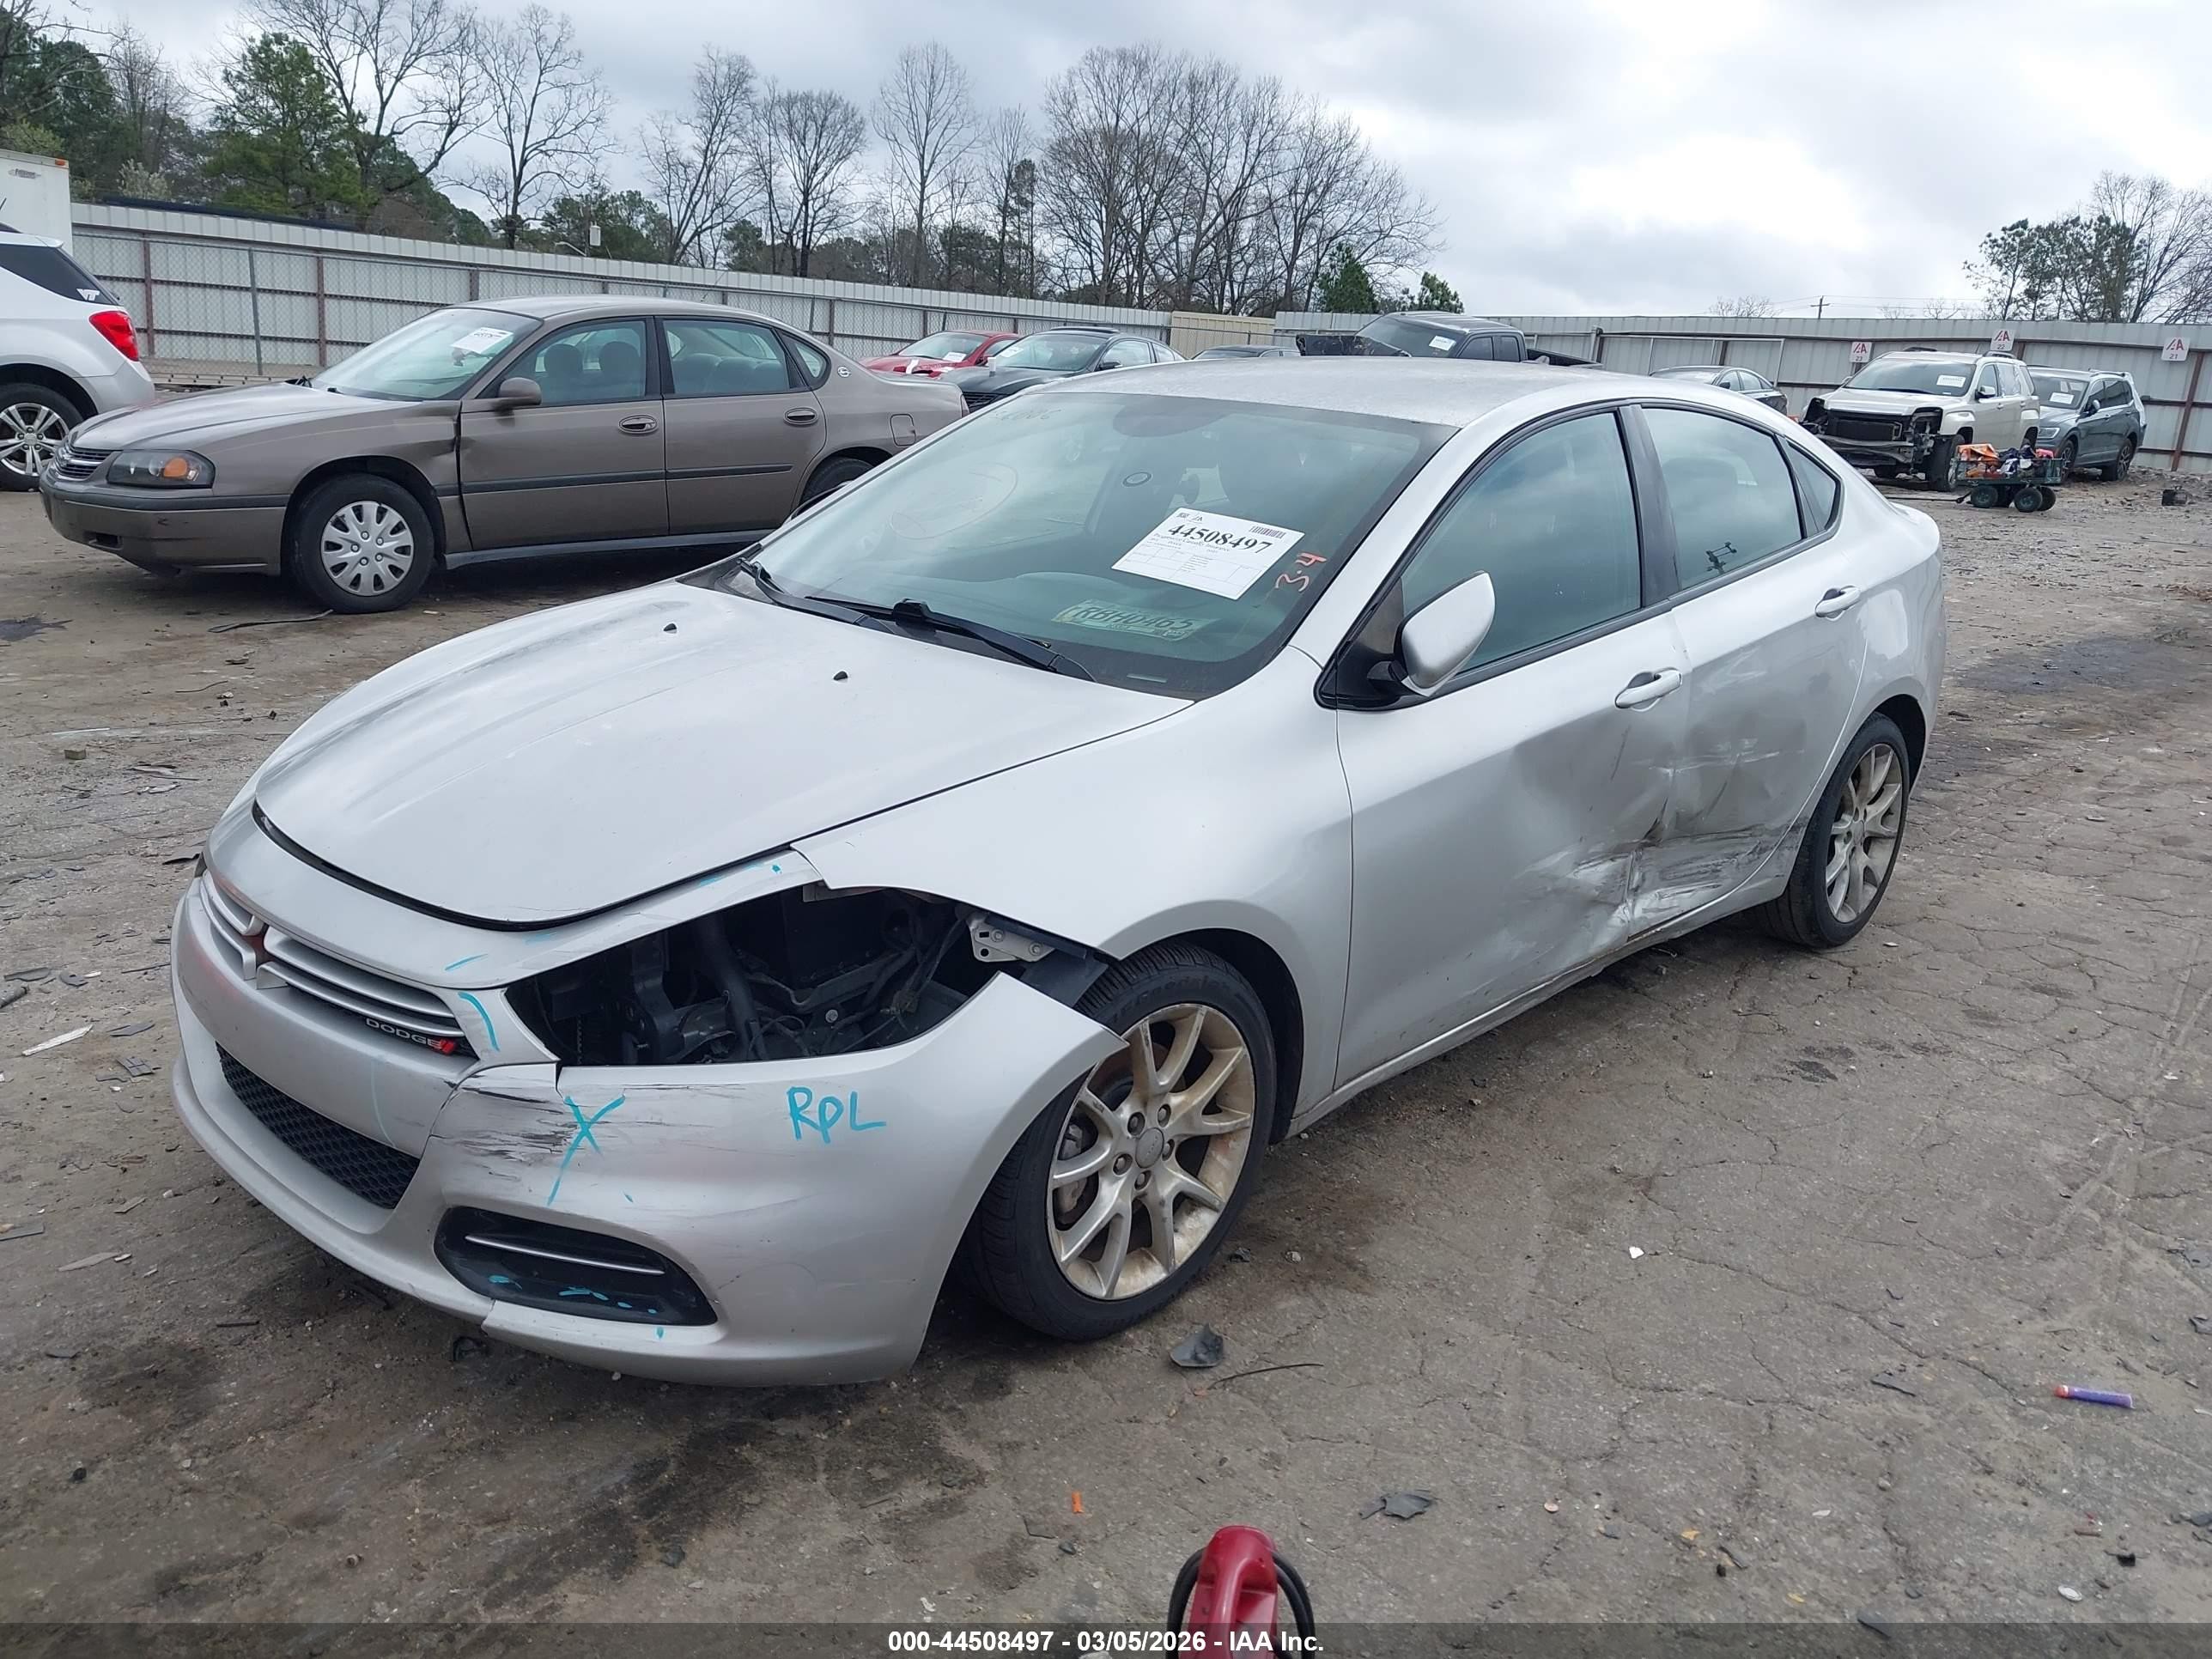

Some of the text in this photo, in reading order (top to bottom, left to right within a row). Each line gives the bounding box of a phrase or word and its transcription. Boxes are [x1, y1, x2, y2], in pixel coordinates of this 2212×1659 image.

[76, 288, 100, 301] VT
[1168, 524, 1273, 554] 44508497
[366, 1018, 443, 1050] DODGE
